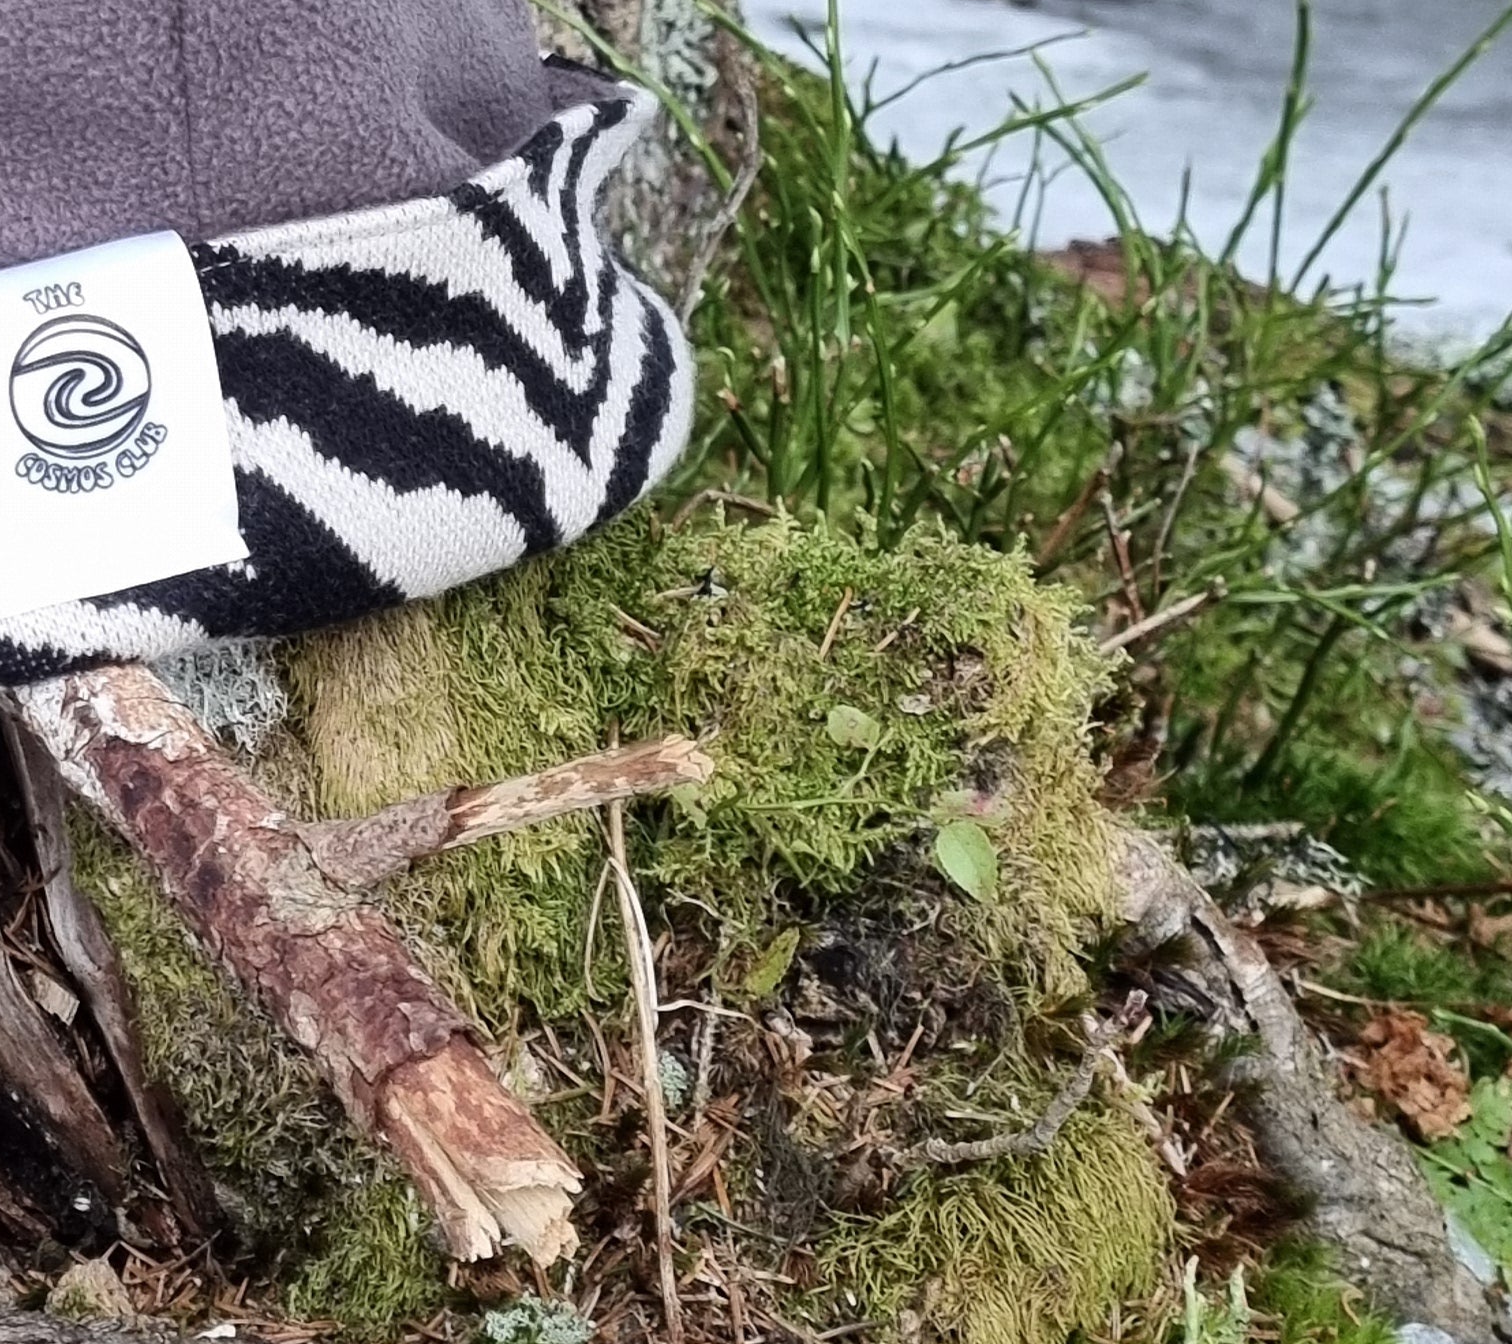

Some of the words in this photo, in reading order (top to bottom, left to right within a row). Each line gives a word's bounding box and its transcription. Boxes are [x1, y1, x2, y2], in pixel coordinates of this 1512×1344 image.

[23, 282, 85, 314] THE
[15, 453, 114, 493] COSMOS
[115, 421, 167, 477] CLUB
